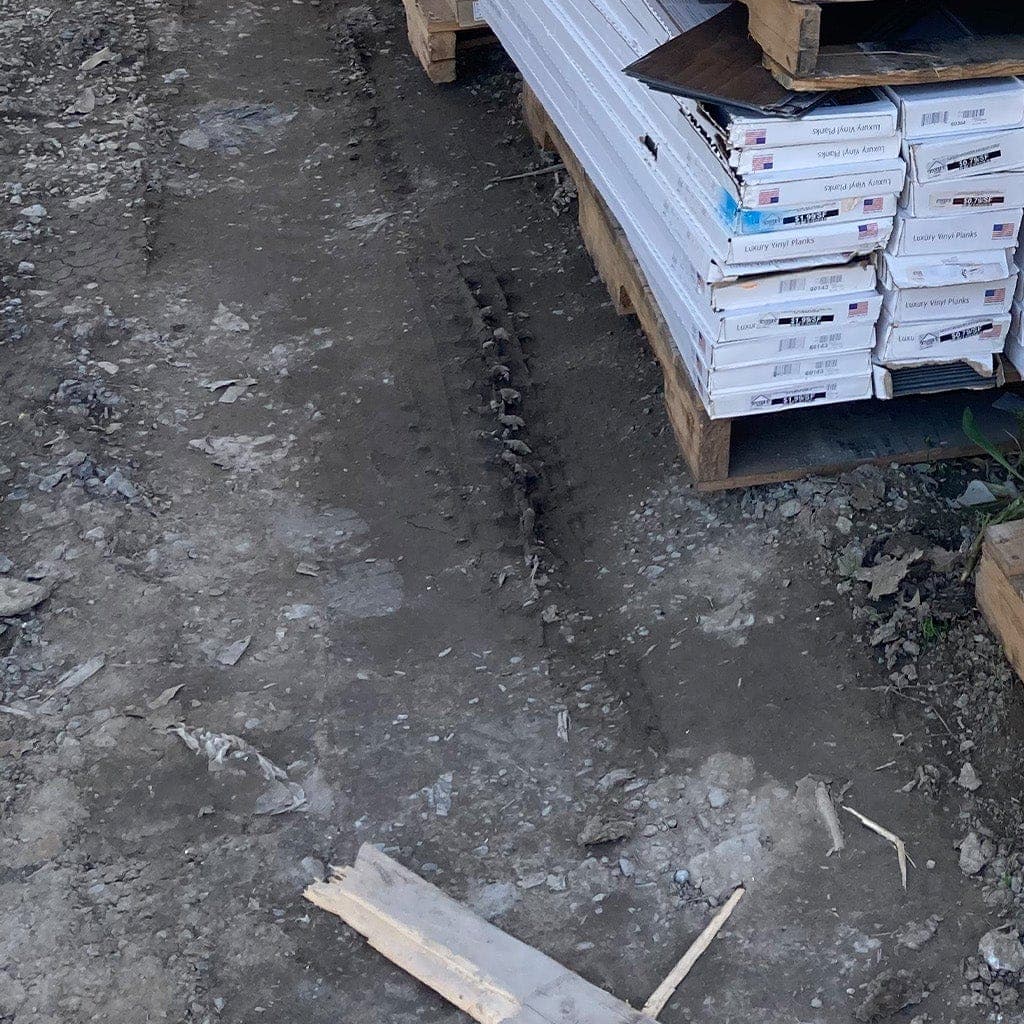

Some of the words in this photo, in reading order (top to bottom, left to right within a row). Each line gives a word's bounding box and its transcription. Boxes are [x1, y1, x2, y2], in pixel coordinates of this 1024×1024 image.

[812, 126, 836, 135] Planks
[837, 125, 856, 135] Vinyl
[858, 124, 880, 134] Luxury
[817, 149, 841, 158] Planks
[842, 147, 860, 156] Vinyl
[862, 146, 885, 155] Luxury
[824, 183, 847, 192] Planks
[849, 180, 866, 190] Vinyl
[866, 179, 891, 188] Luxury
[913, 234, 936, 242] Luxury
[745, 243, 769, 253] Luxury
[771, 241, 789, 250] Vinyl
[791, 237, 815, 246] Planks
[905, 300, 927, 309] Luxury
[930, 299, 946, 307] Vinyl
